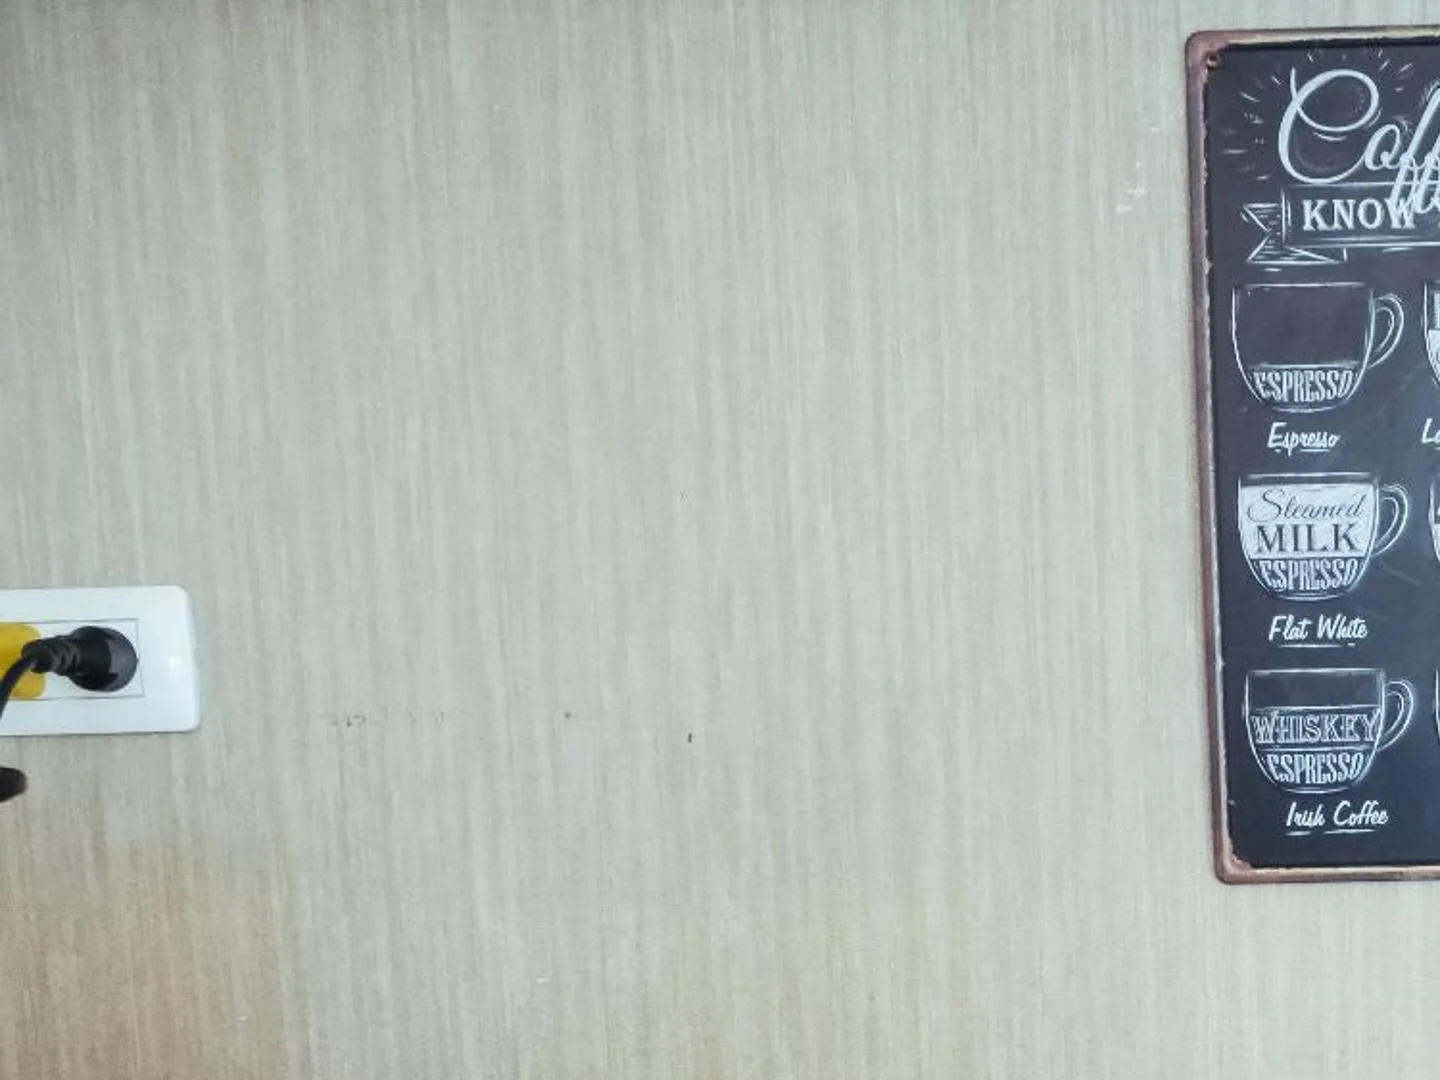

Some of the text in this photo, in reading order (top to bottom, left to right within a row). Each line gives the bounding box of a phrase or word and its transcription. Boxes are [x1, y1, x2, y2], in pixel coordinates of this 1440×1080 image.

[1303, 198, 1416, 232] KNOW
[1253, 369, 1353, 402] ESPRESSO
[1267, 421, 1341, 456] Espresso
[1248, 488, 1368, 523] Steamed
[1255, 523, 1363, 554] MILK
[1258, 558, 1359, 592] ESPRESSO
[1269, 613, 1369, 642] Flat White
[1250, 708, 1381, 744] WHISKEY
[1266, 752, 1365, 785] ESPRESSO
[1285, 800, 1389, 827] Irish Coffee
